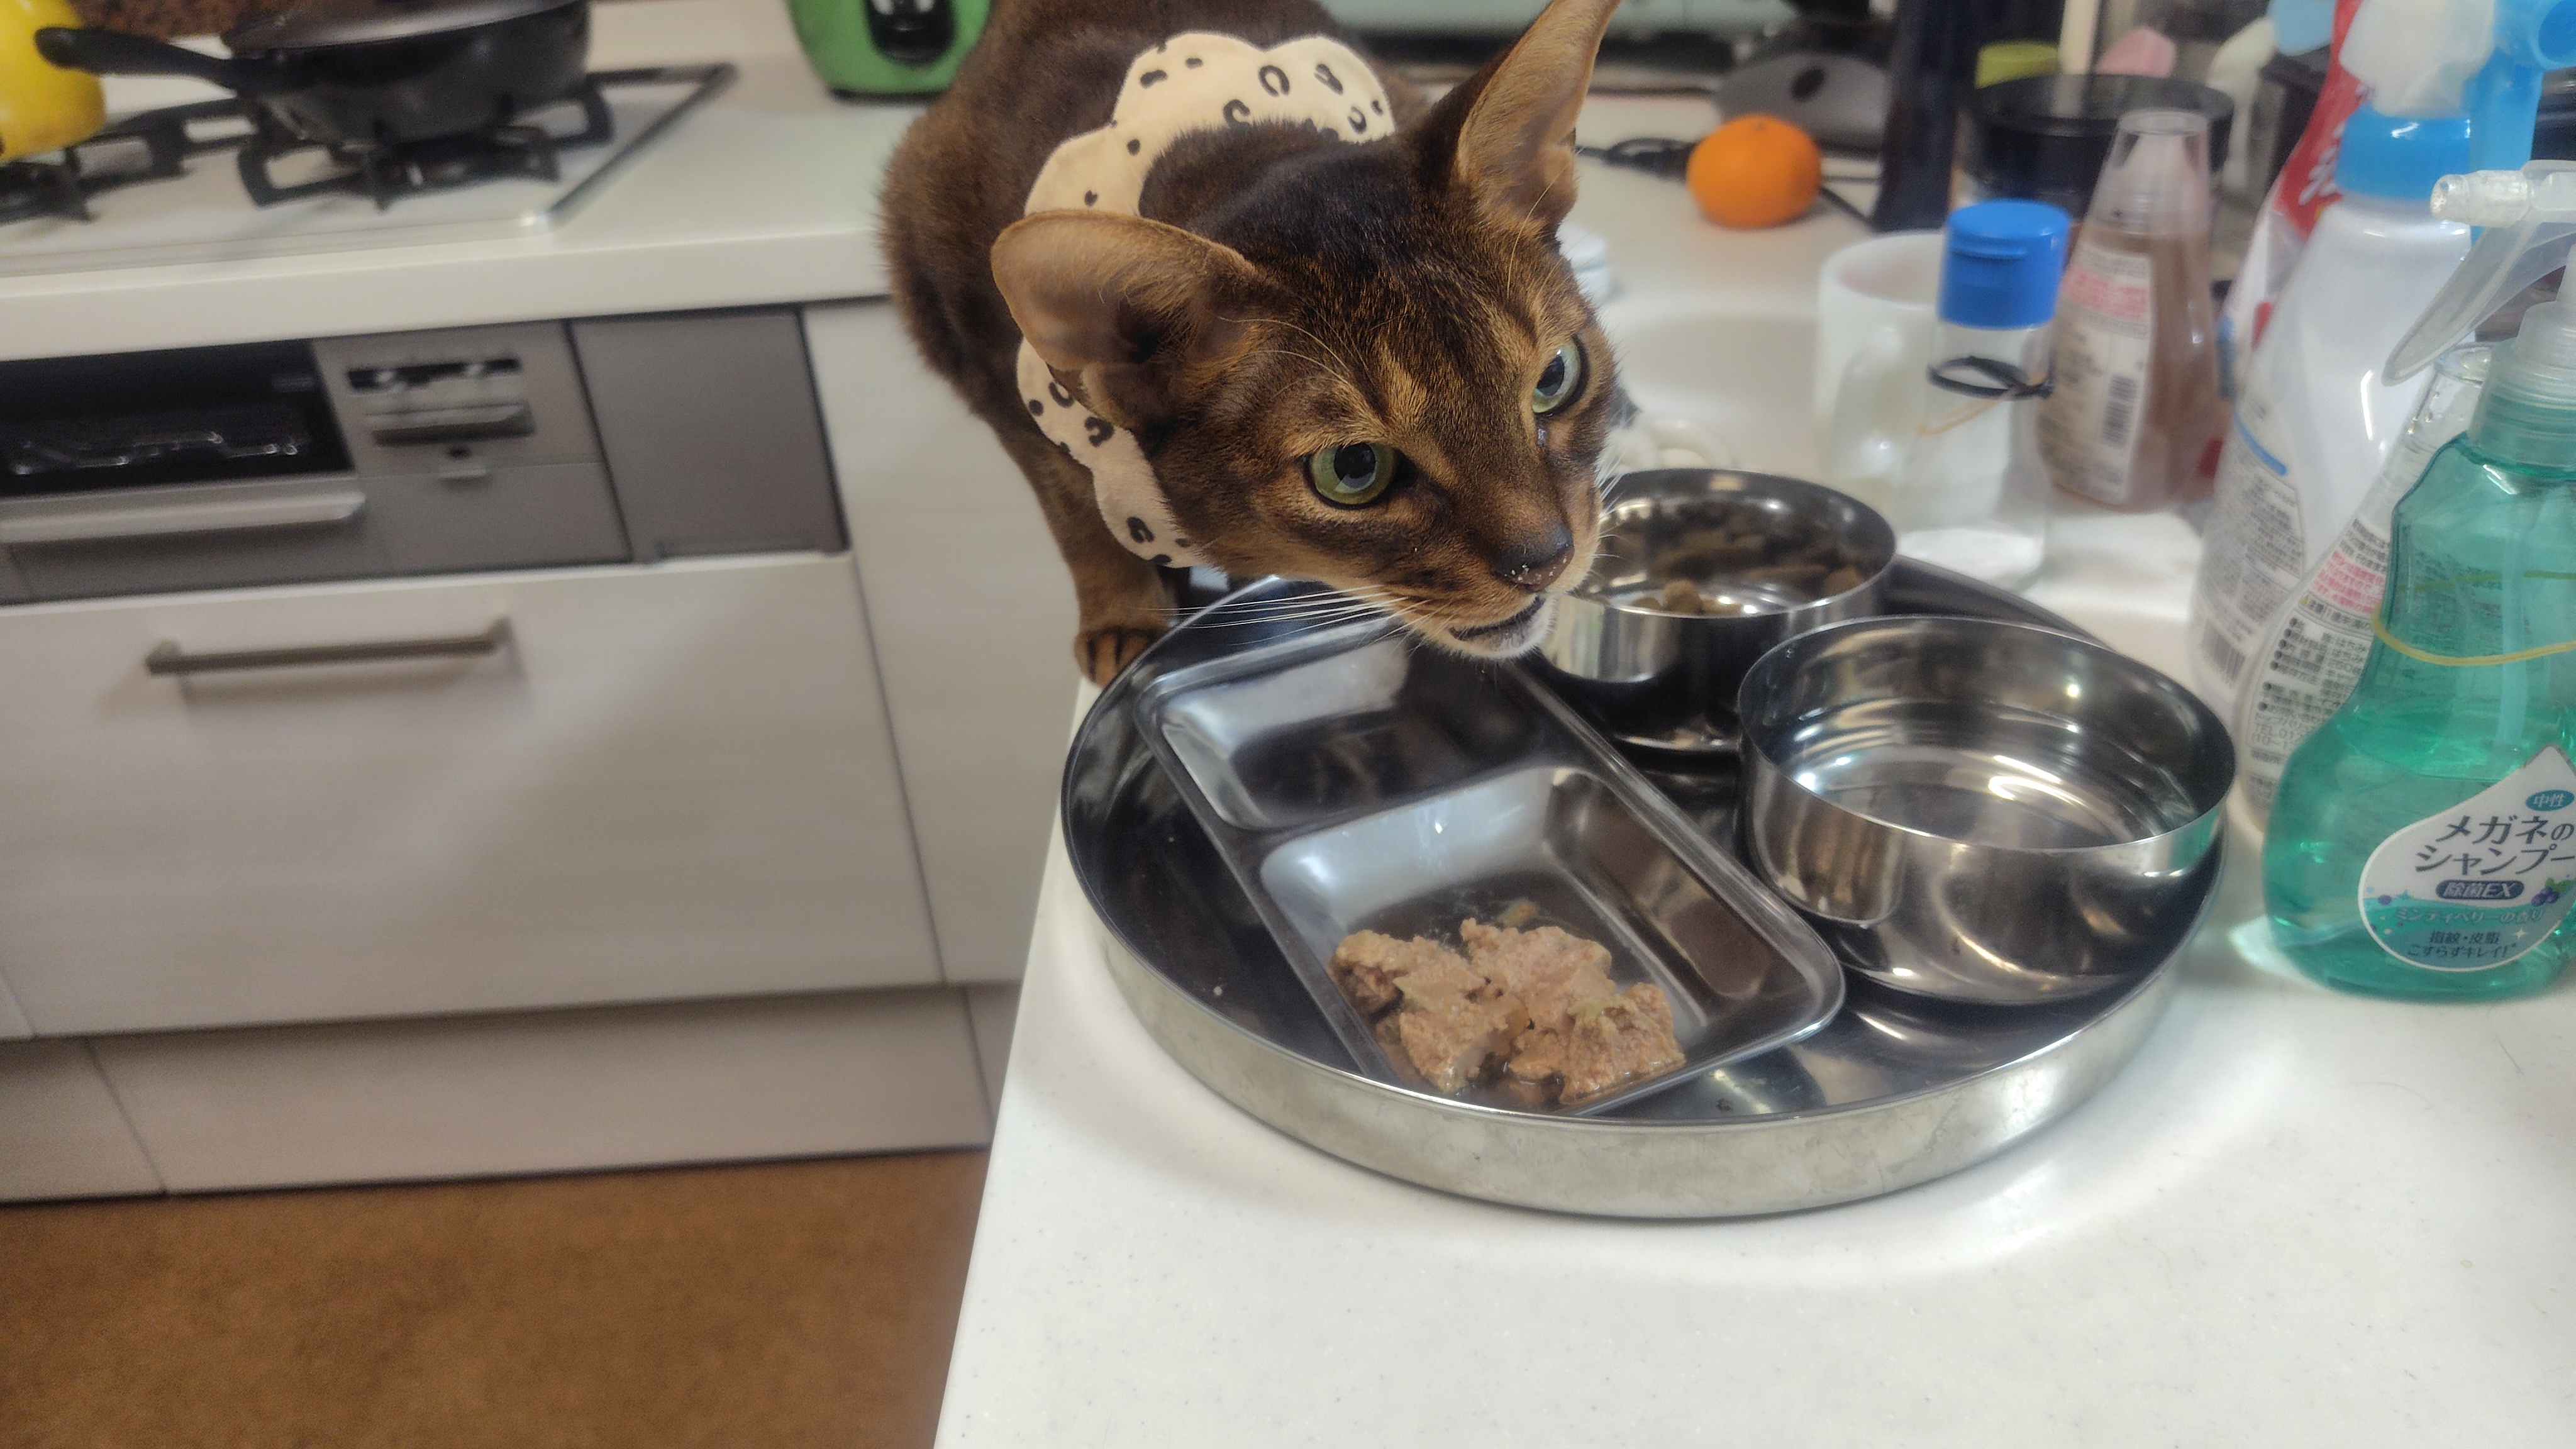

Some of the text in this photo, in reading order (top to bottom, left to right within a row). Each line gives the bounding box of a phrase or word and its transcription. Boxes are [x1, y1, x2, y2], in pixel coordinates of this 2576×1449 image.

[2533, 792, 2565, 808] 中性
[2435, 814, 2575, 845] メガネの
[2414, 843, 2575, 876] シャンプー
[2442, 882, 2516, 898] 除菌EX
[2396, 907, 2544, 924] ミンティベリーの香り
